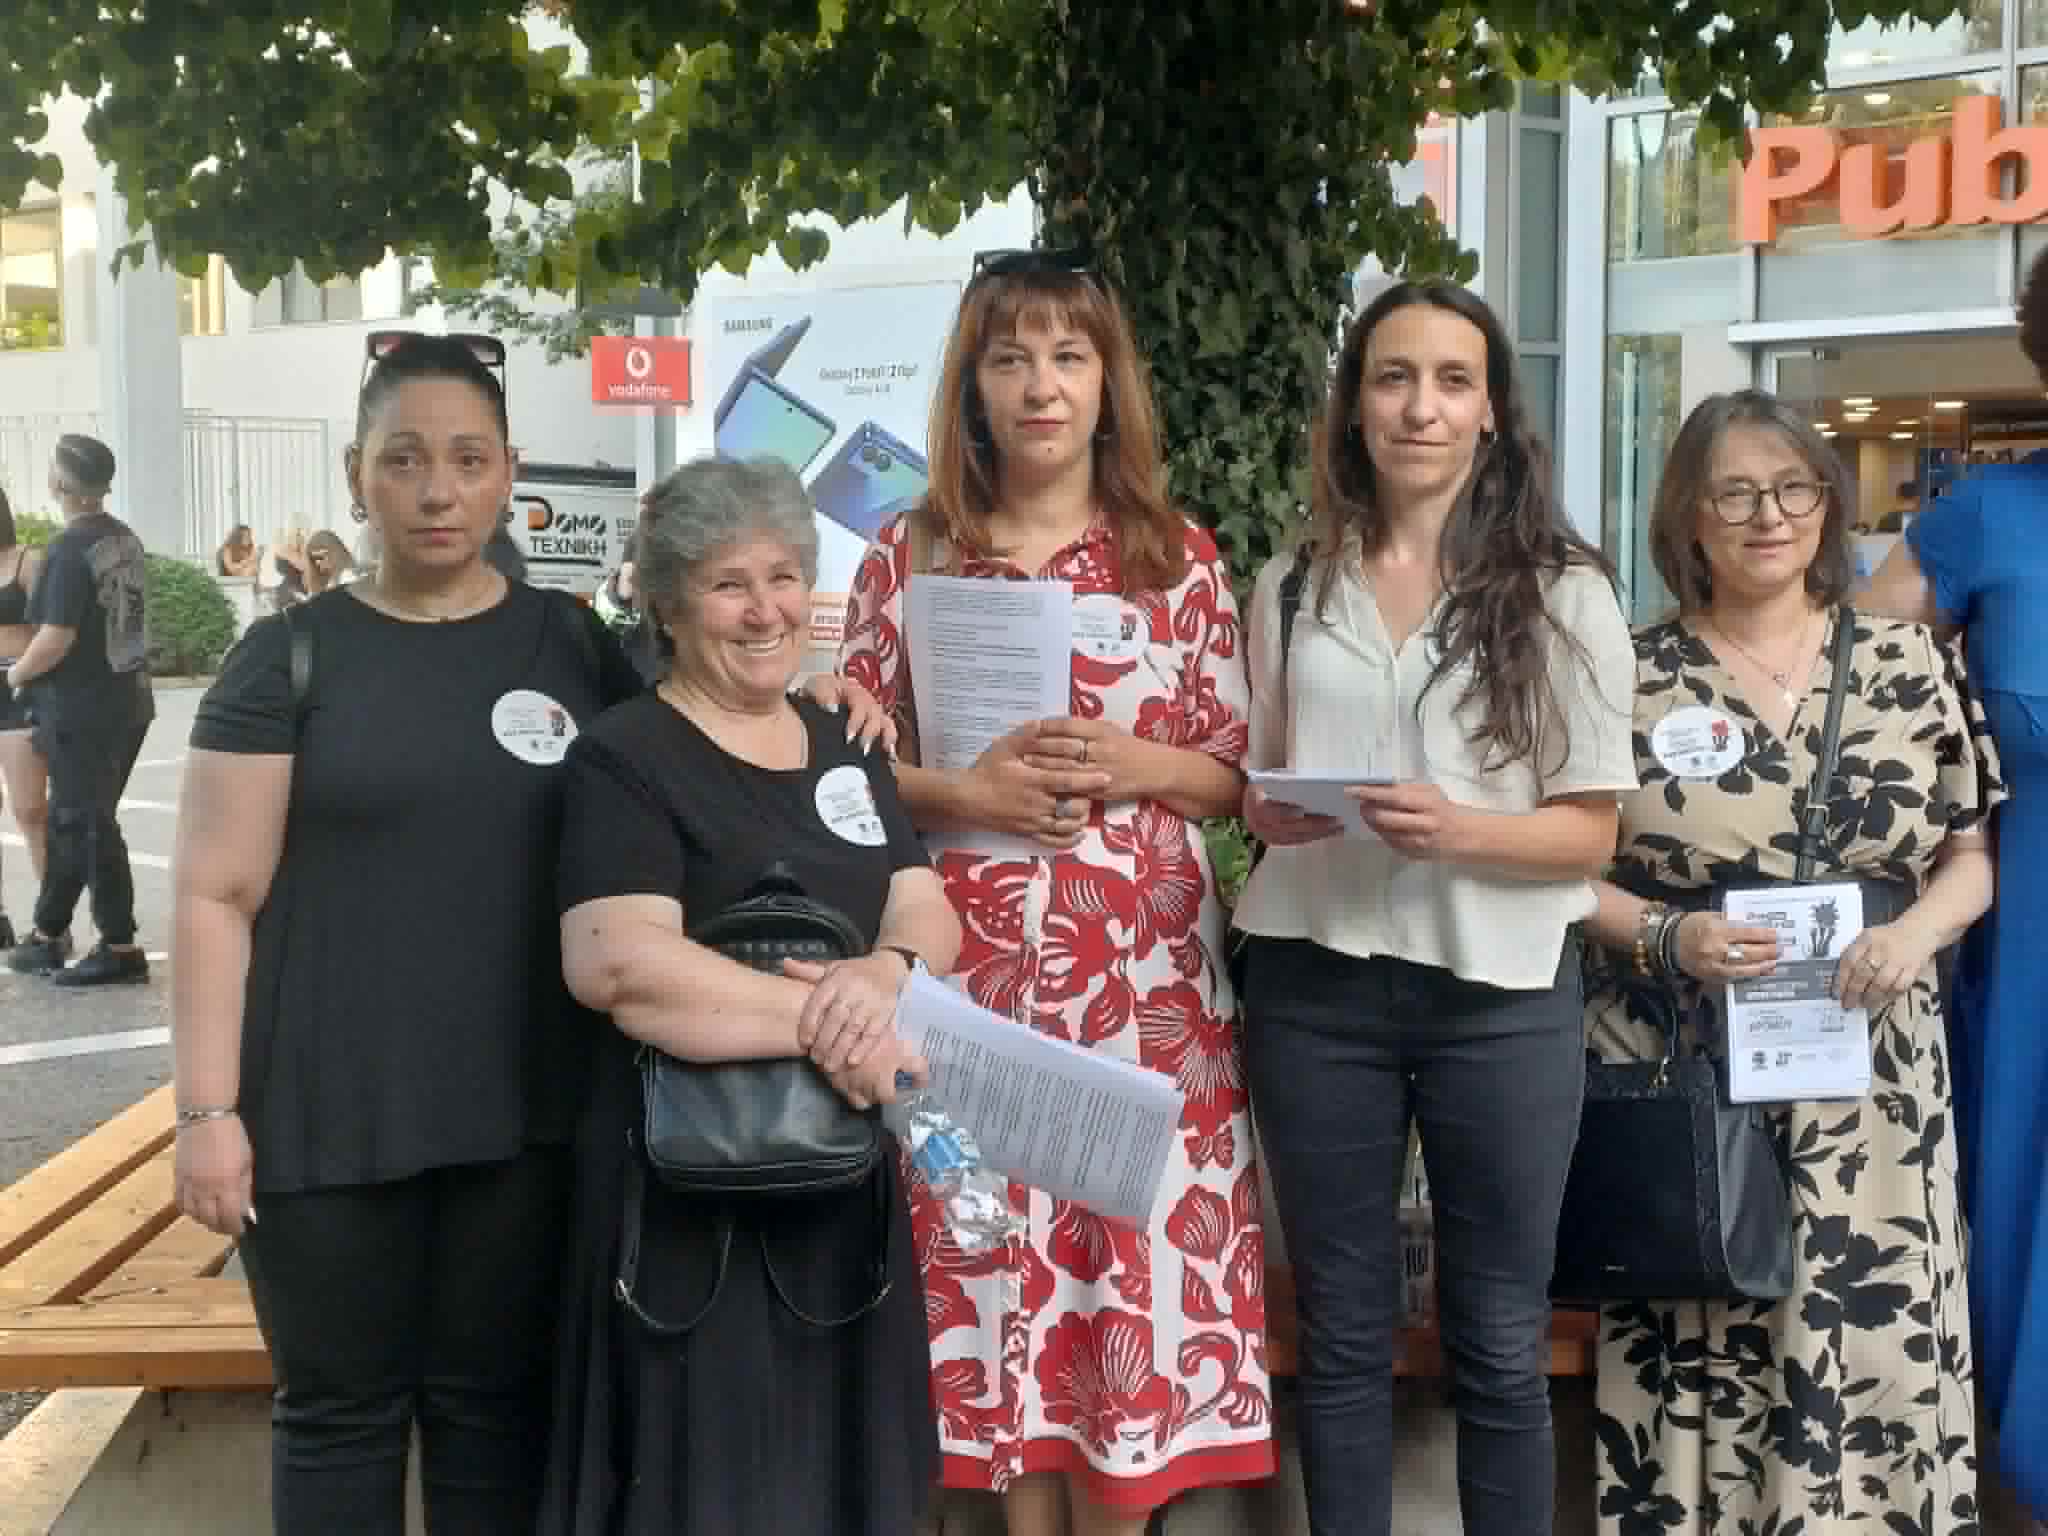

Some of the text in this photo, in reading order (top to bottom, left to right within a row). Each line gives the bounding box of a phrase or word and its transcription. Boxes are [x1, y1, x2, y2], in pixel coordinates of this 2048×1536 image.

[1730, 95, 2048, 242] Pub
[724, 317, 773, 332] SAMSUNG
[608, 382, 672, 399] vodafone
